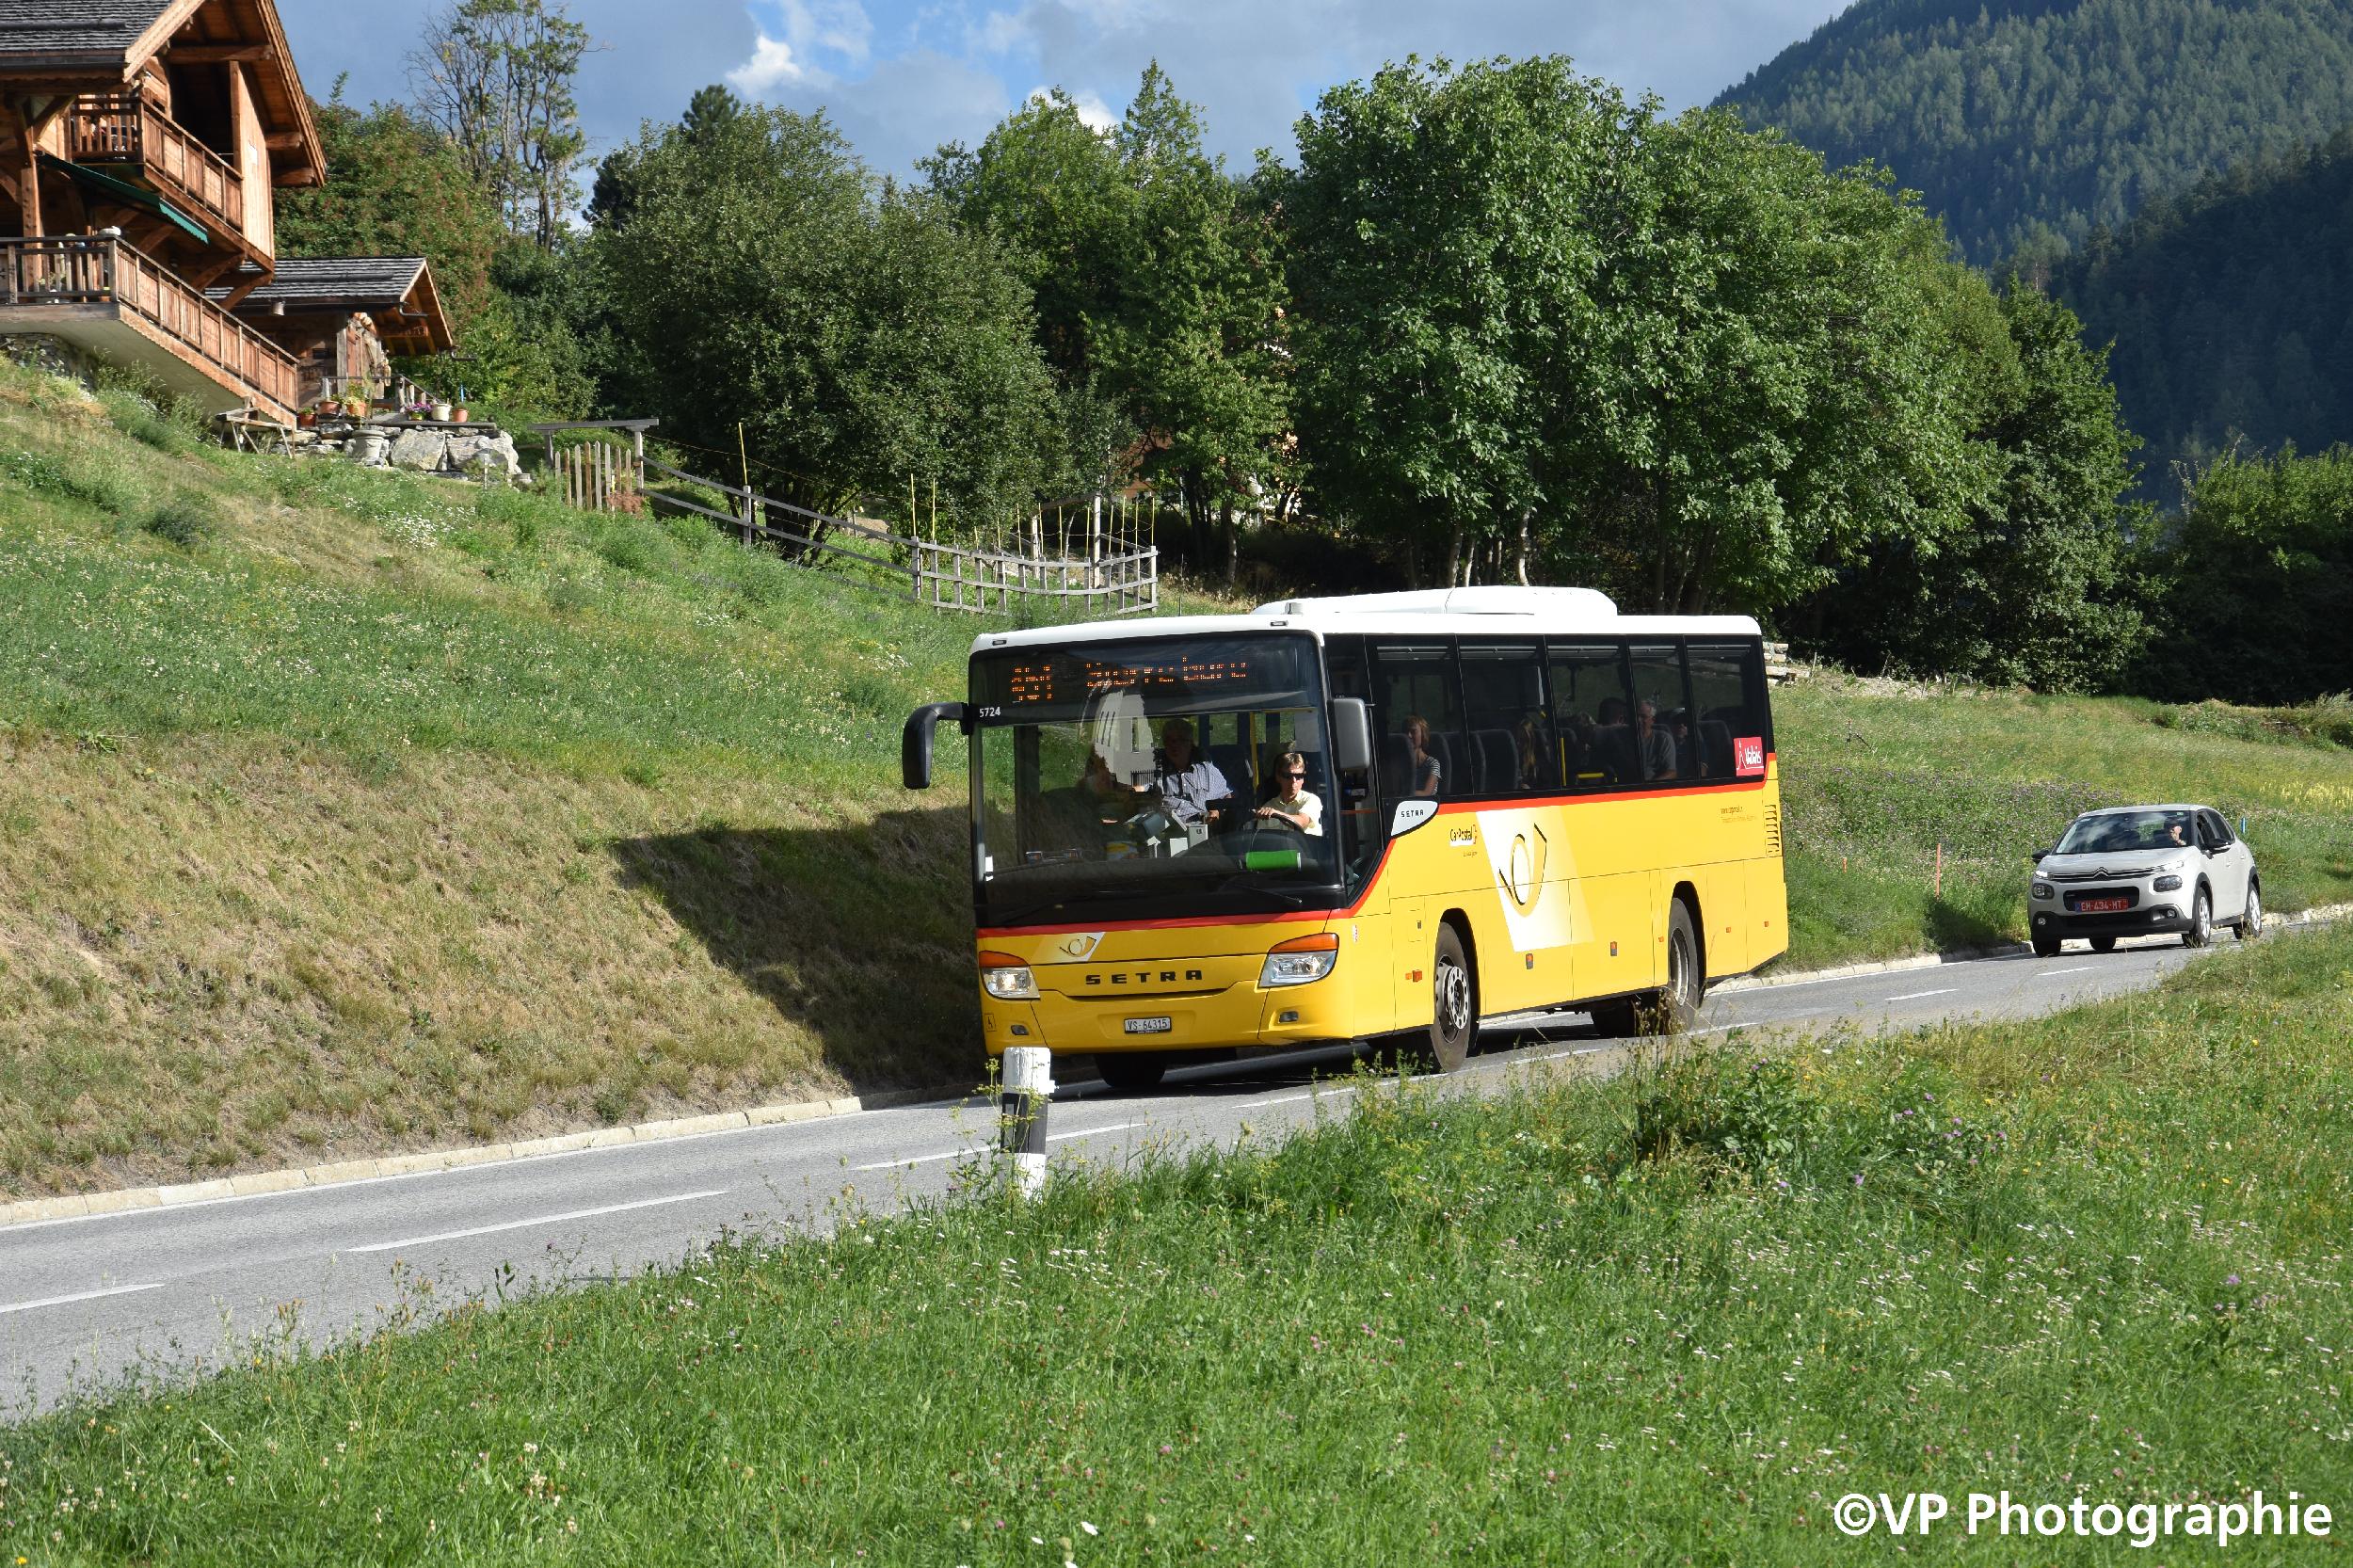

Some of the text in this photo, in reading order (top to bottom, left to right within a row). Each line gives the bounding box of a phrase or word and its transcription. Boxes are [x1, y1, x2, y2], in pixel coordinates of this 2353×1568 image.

[979, 706, 1001, 718] 5724
[1401, 809, 1424, 818] SETRA
[1085, 970, 1203, 984] SETRA
